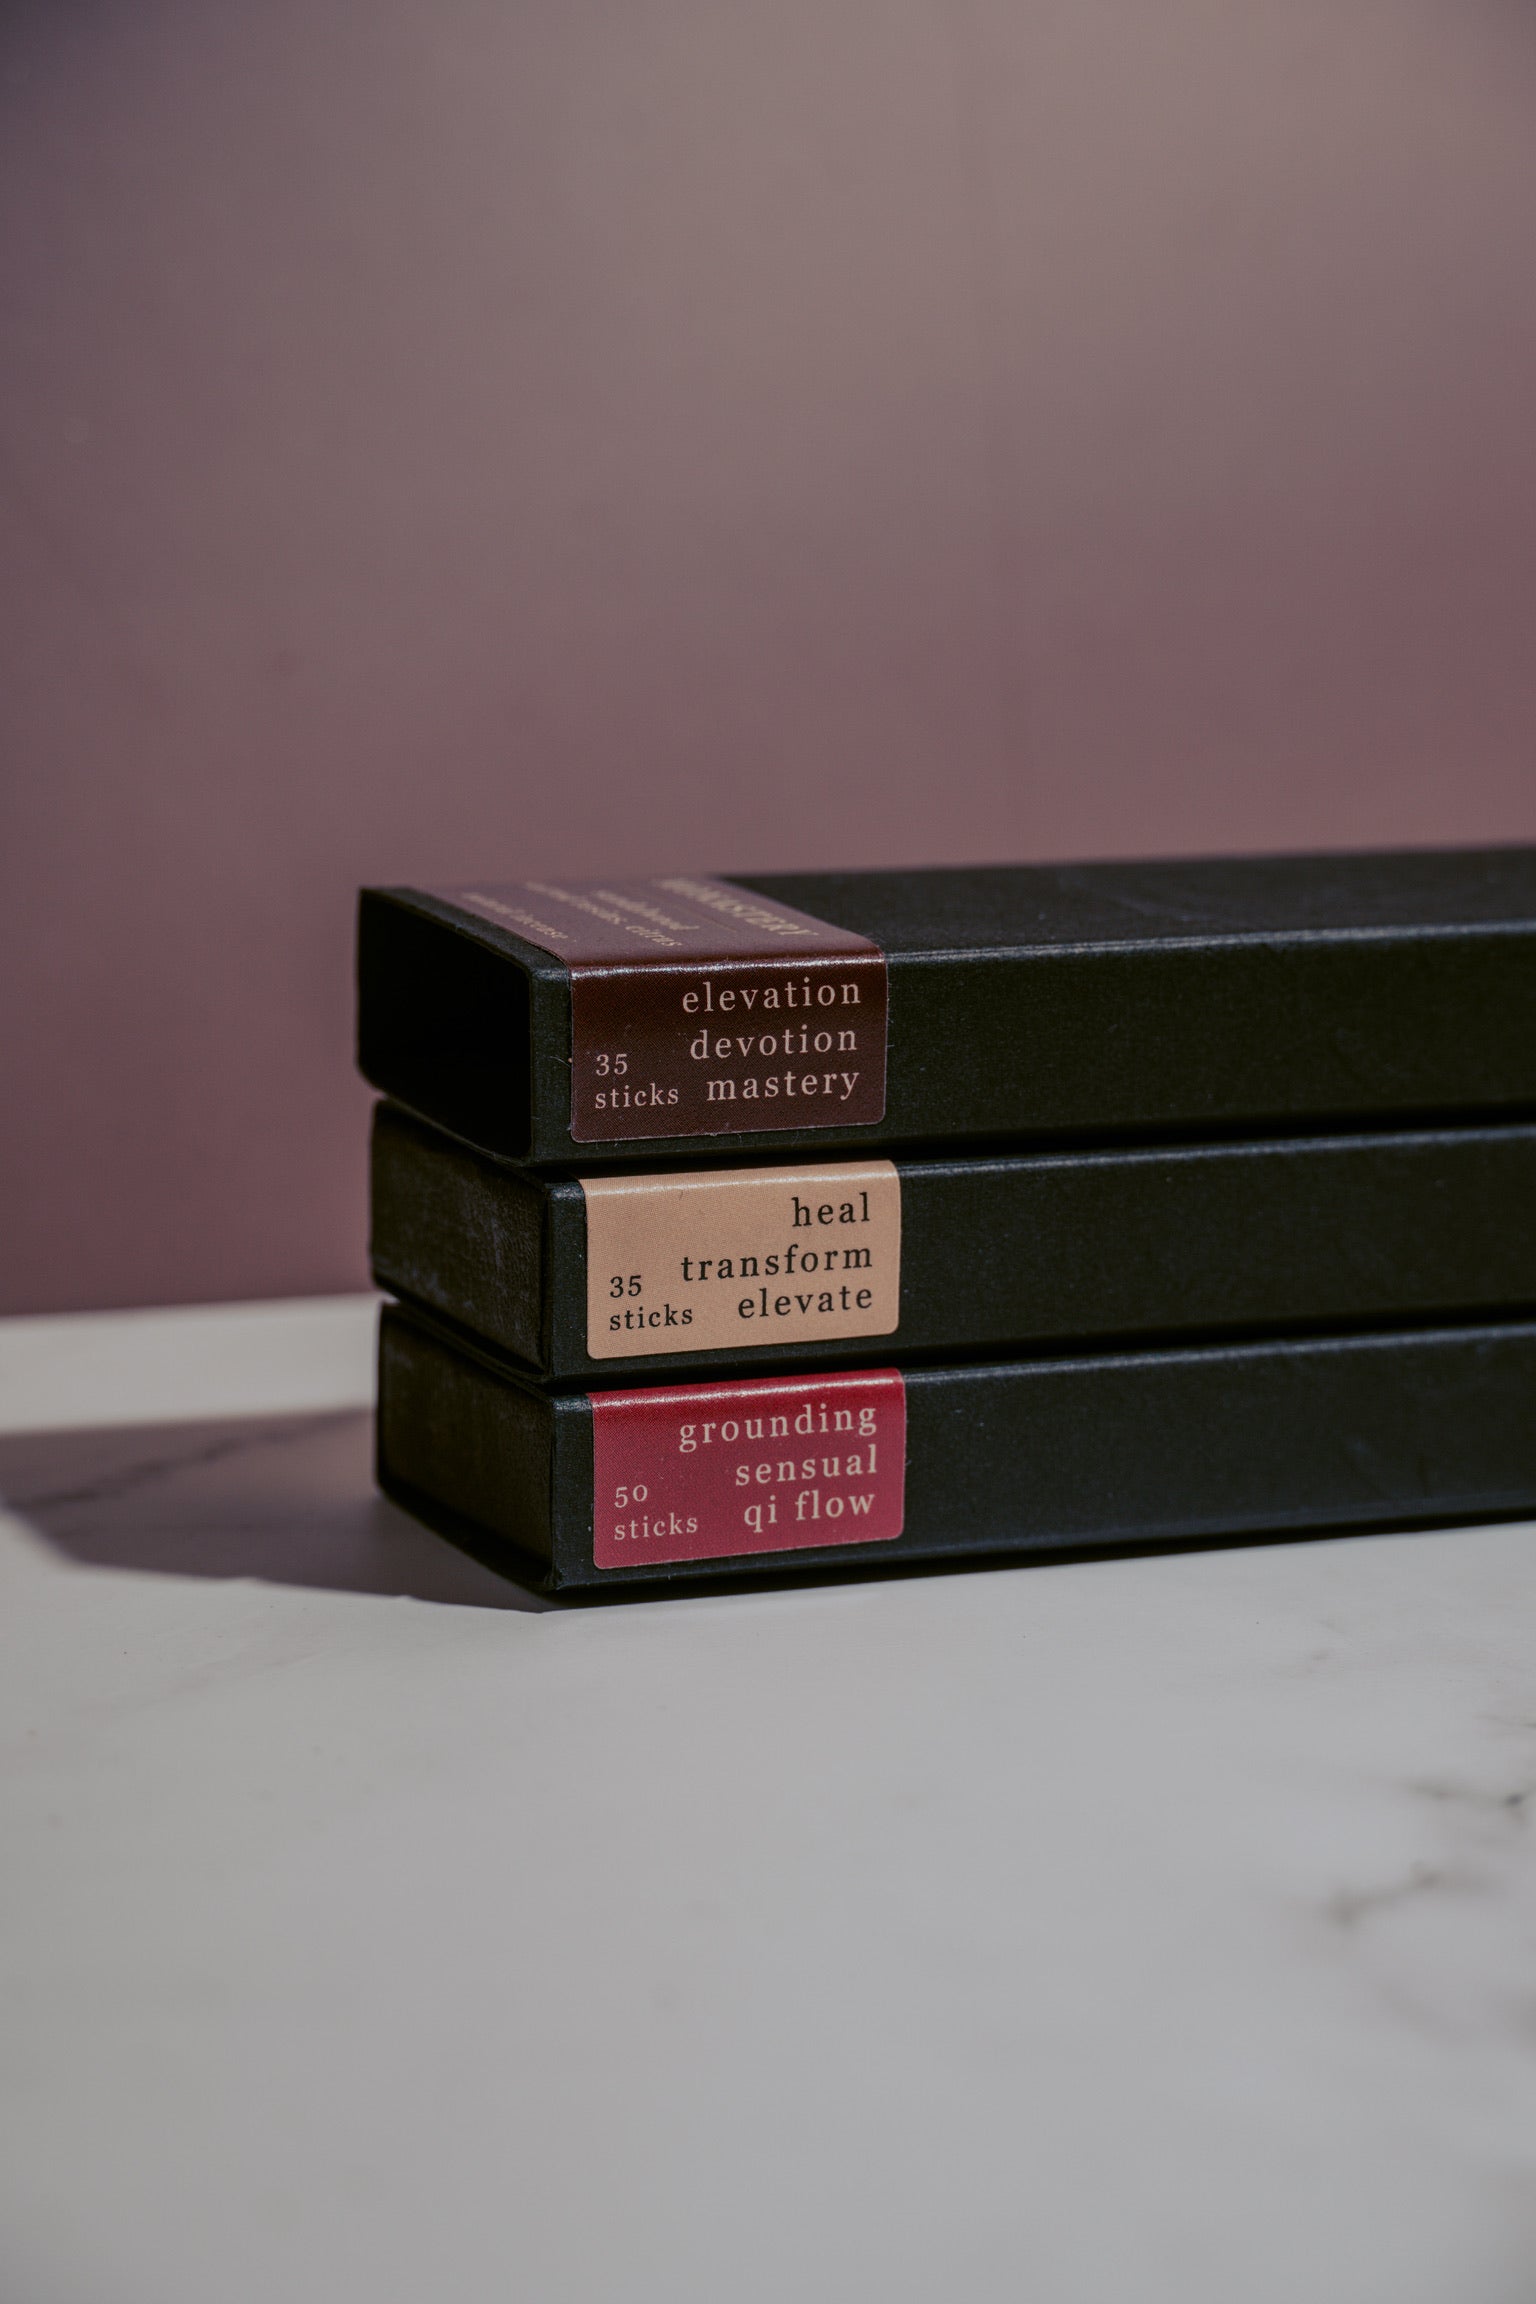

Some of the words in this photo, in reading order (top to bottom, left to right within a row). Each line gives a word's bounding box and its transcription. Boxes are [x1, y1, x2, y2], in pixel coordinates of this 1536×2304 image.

[682, 976, 861, 1013] elevation
[690, 1024, 858, 1060] devotion
[595, 1054, 628, 1076] 35
[595, 1083, 679, 1109] sticks
[706, 1071, 860, 1101] mastery
[792, 1192, 871, 1227] heal
[681, 1244, 873, 1282] transform
[609, 1275, 643, 1298] 35
[609, 1304, 694, 1331] sticks
[738, 1288, 873, 1319] elevate
[679, 1402, 877, 1453] grounding
[735, 1444, 878, 1486] sensual
[614, 1484, 649, 1508] 50
[743, 1495, 778, 1533] qi
[795, 1490, 875, 1522] flow
[614, 1513, 699, 1541] sticks
